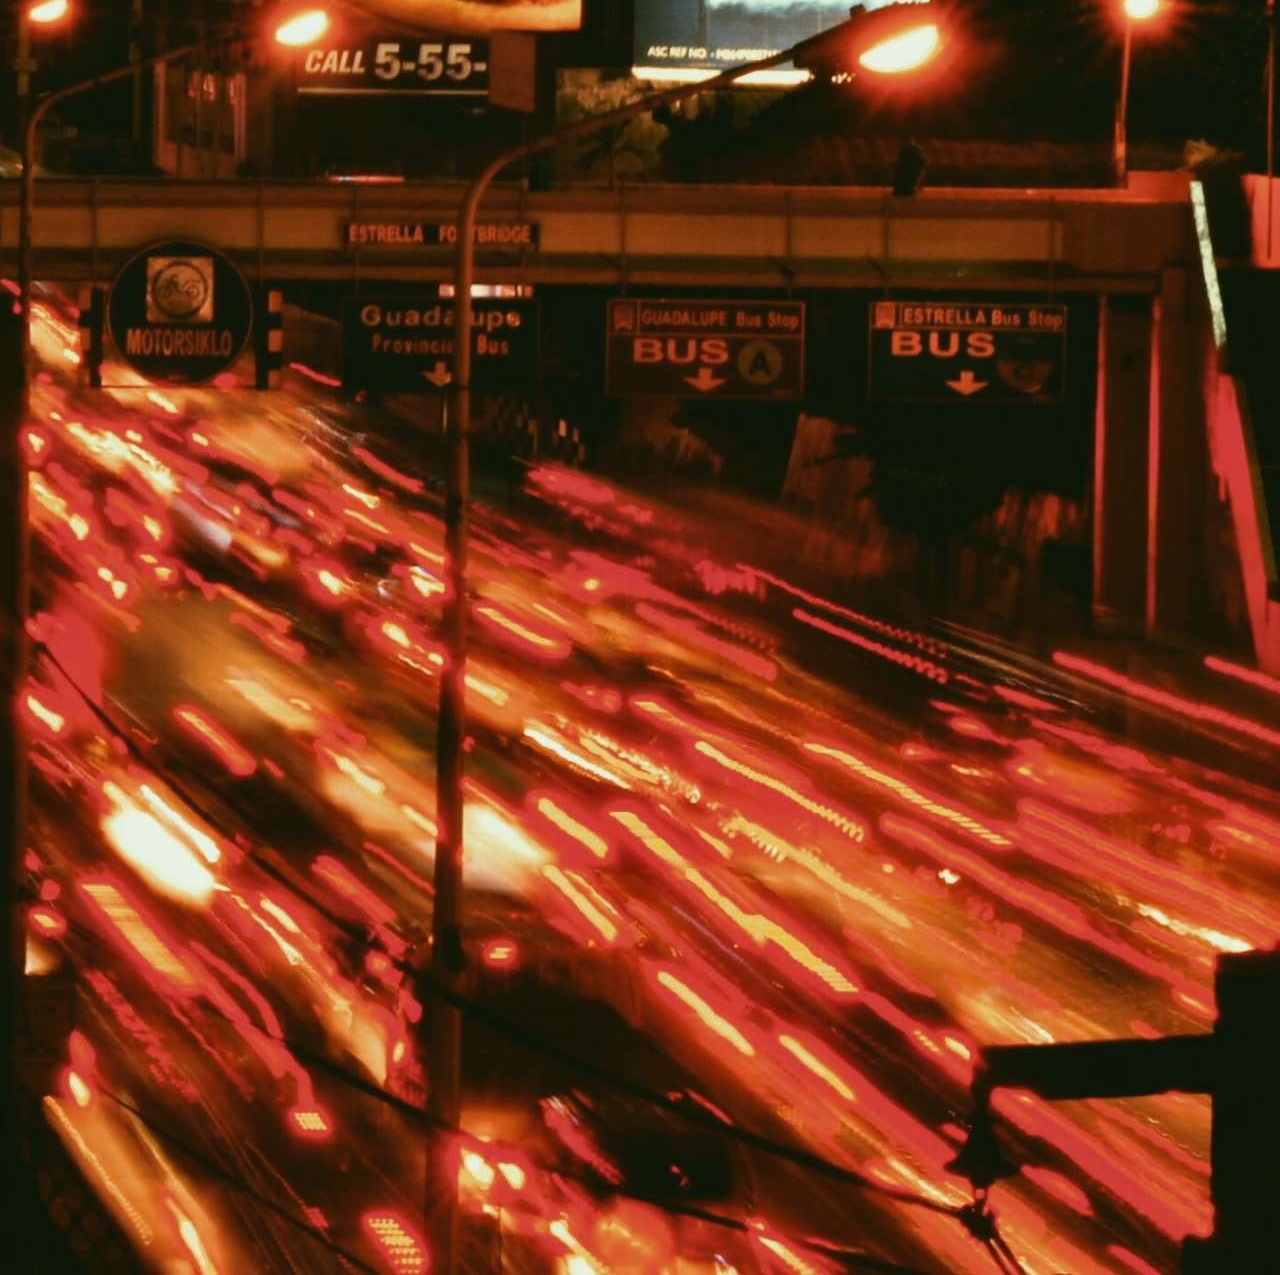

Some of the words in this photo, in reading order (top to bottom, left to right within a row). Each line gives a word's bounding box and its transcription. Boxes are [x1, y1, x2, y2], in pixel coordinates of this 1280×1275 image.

[304, 49, 366, 74] CALL
[349, 224, 424, 244] ESTRELLA
[440, 224, 530, 244] FOTBRIDGE
[360, 304, 522, 332] Guadaupe
[642, 309, 727, 326] GUADALUPE
[736, 311, 761, 328] Bus
[767, 311, 799, 329] Stop
[903, 307, 986, 325] ESTRELLA
[991, 308, 1021, 326] Bus
[1028, 309, 1063, 329] Stop
[125, 327, 232, 359] MOTORSIKLO
[476, 334, 510, 355] Bus
[891, 330, 996, 358] BUS
[633, 338, 730, 365] BUS
[749, 350, 771, 375] A
